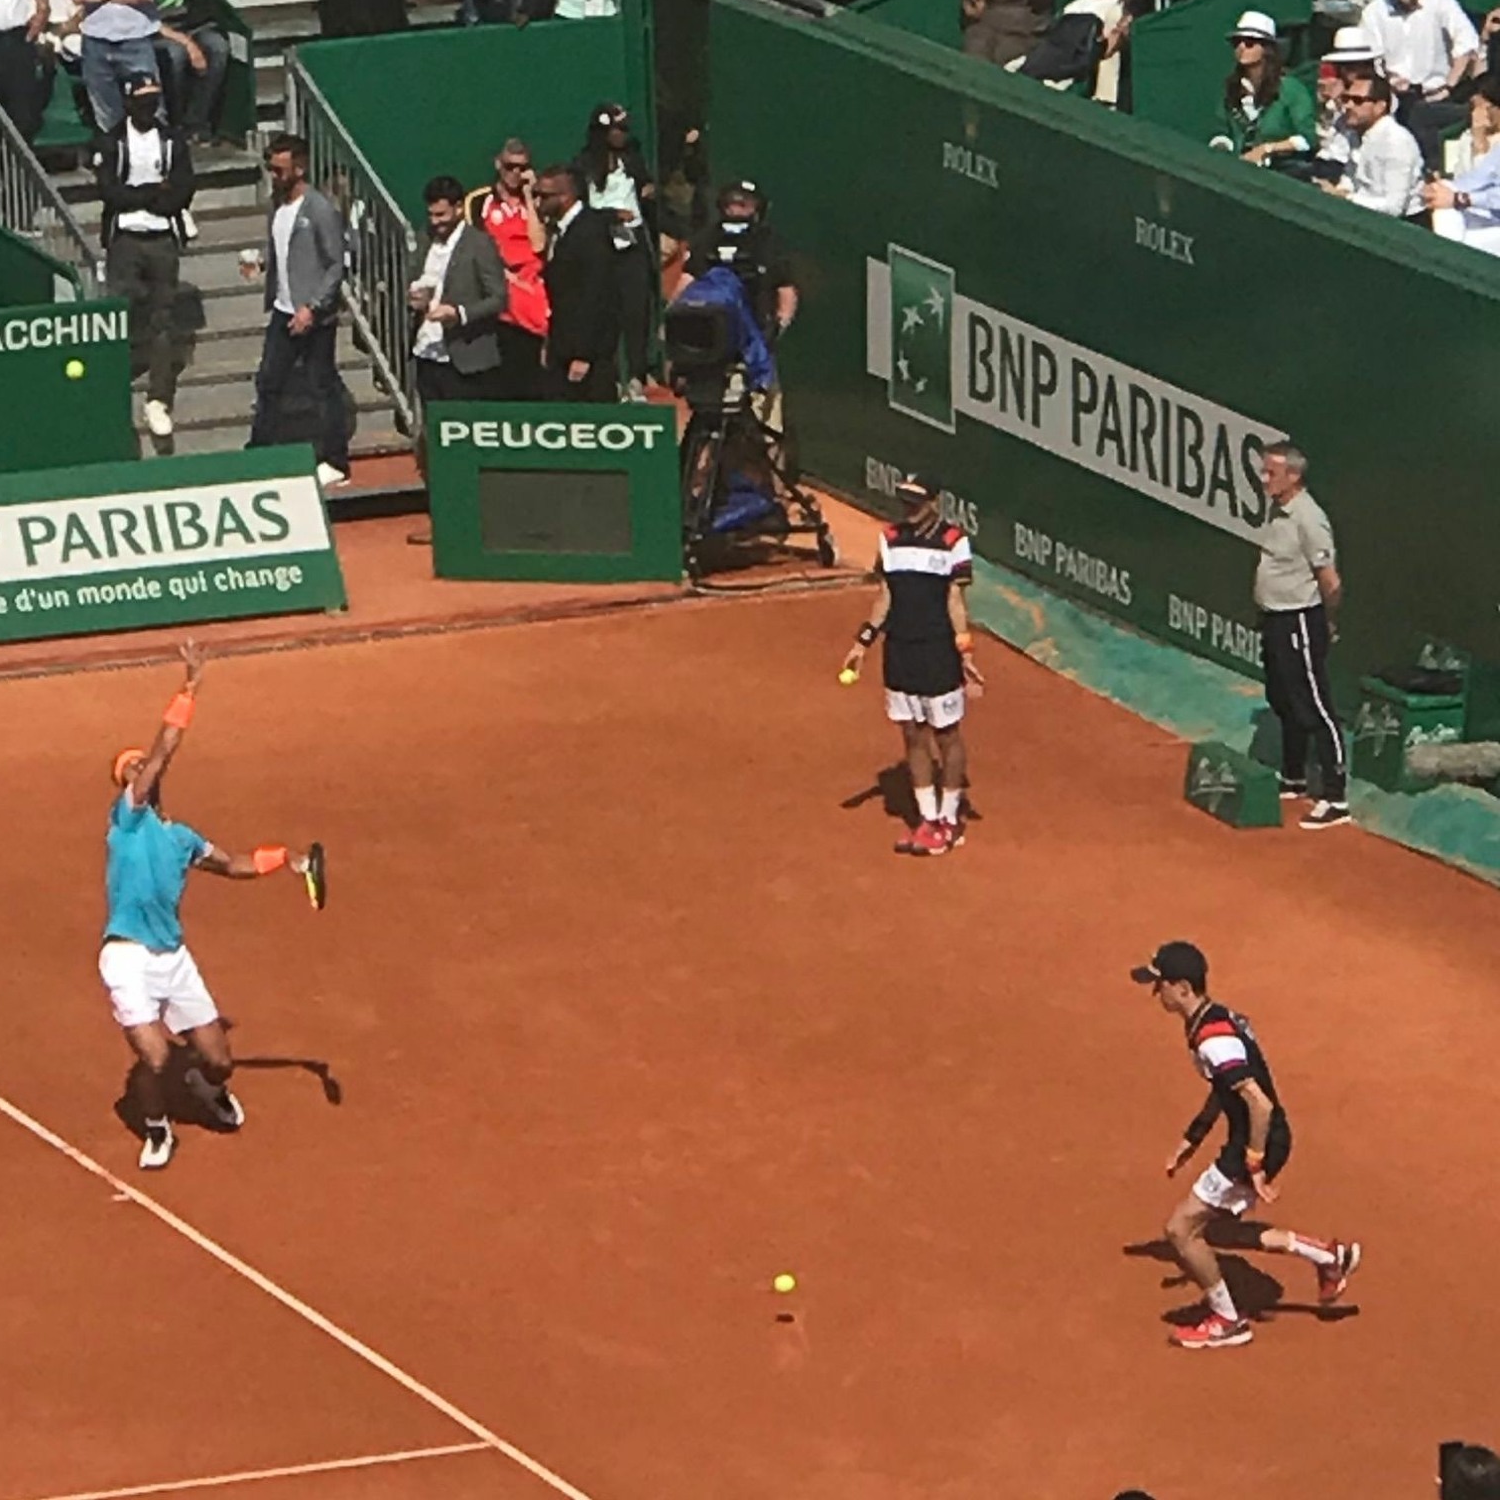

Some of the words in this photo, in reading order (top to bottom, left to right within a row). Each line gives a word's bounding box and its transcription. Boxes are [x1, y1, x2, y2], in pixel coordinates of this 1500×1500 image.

[942, 141, 1000, 189] ROLEX
[1134, 216, 1197, 267] ROLEX
[439, 421, 664, 450] PEUGEOT
[967, 310, 1058, 430] BNP
[1071, 357, 1272, 530] PARIBAS
[18, 491, 292, 568] PARIBAS
[15, 585, 71, 613] d'un
[77, 575, 162, 605] monde
[168, 571, 208, 603] qui
[215, 561, 303, 597] change
[1015, 522, 1052, 568] BNP
[1055, 542, 1132, 606] PARIBAS
[1168, 594, 1207, 640] BNP
